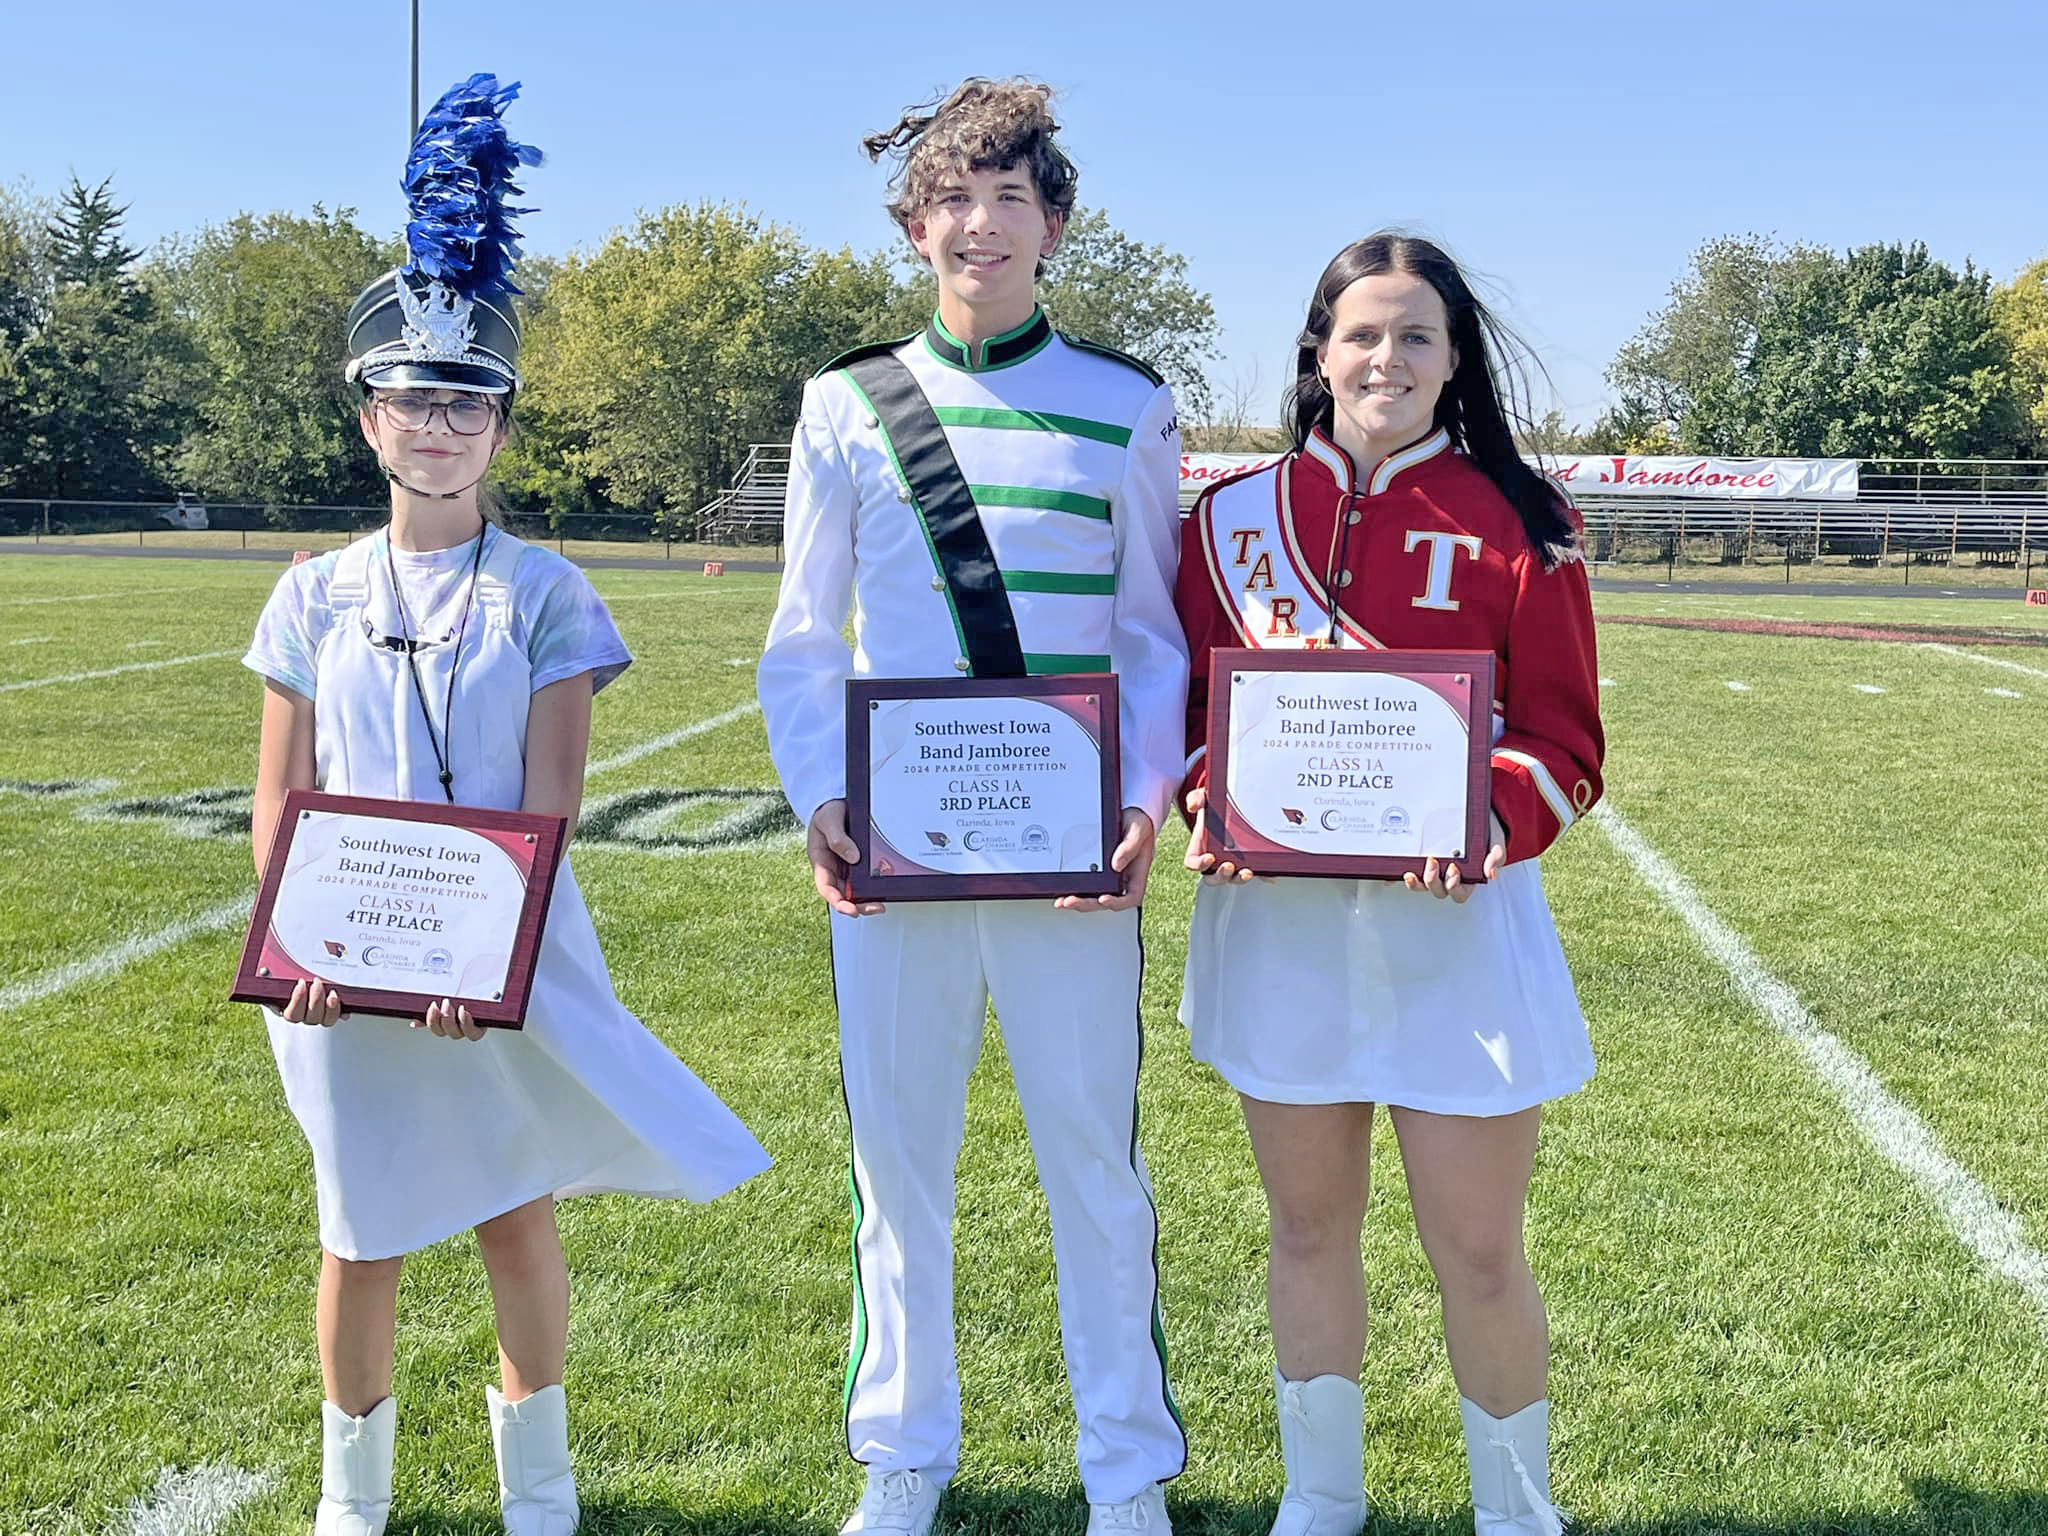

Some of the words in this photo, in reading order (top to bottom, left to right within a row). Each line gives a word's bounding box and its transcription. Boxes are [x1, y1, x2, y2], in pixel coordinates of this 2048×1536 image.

[1600, 458, 1777, 487] Jamboree
[1403, 529, 1483, 612] T
[2030, 591, 2047, 605] 40
[1276, 695, 1369, 711] Southwest
[1373, 697, 1417, 712] Iowa
[914, 720, 1005, 736] Southwest
[1009, 720, 1051, 734] Iowa
[1280, 719, 1325, 734] Band
[1329, 720, 1416, 737] Jamboree
[920, 743, 963, 760] Band
[967, 743, 1051, 761] Jamboree
[1263, 739, 1290, 748] 2024
[1295, 740, 1341, 749] PARADE
[1347, 741, 1432, 751] COMPETITION
[903, 765, 930, 773] 2024
[935, 764, 980, 773] PARADE
[985, 762, 1067, 772] COMPETITION
[1308, 757, 1360, 771] CLASS
[1367, 758, 1384, 772] 1A
[949, 780, 999, 793] CLASS
[1006, 780, 1022, 792] 1A
[1297, 773, 1332, 787] 2ND
[1338, 774, 1393, 789] PLACE
[940, 797, 972, 811] 3RD
[977, 796, 1031, 810] PLACE
[339, 835, 434, 859] Southwest
[438, 846, 481, 864] Iowa
[339, 857, 385, 875] Band
[386, 863, 475, 886] Jamboree
[317, 875, 345, 884] 2024
[350, 878, 398, 890] PARADE
[403, 884, 488, 900] COMPETITION
[359, 895, 414, 912] CLASS
[419, 902, 437, 915] 1A
[345, 909, 382, 926] 4TH
[386, 914, 444, 933] PLACE
